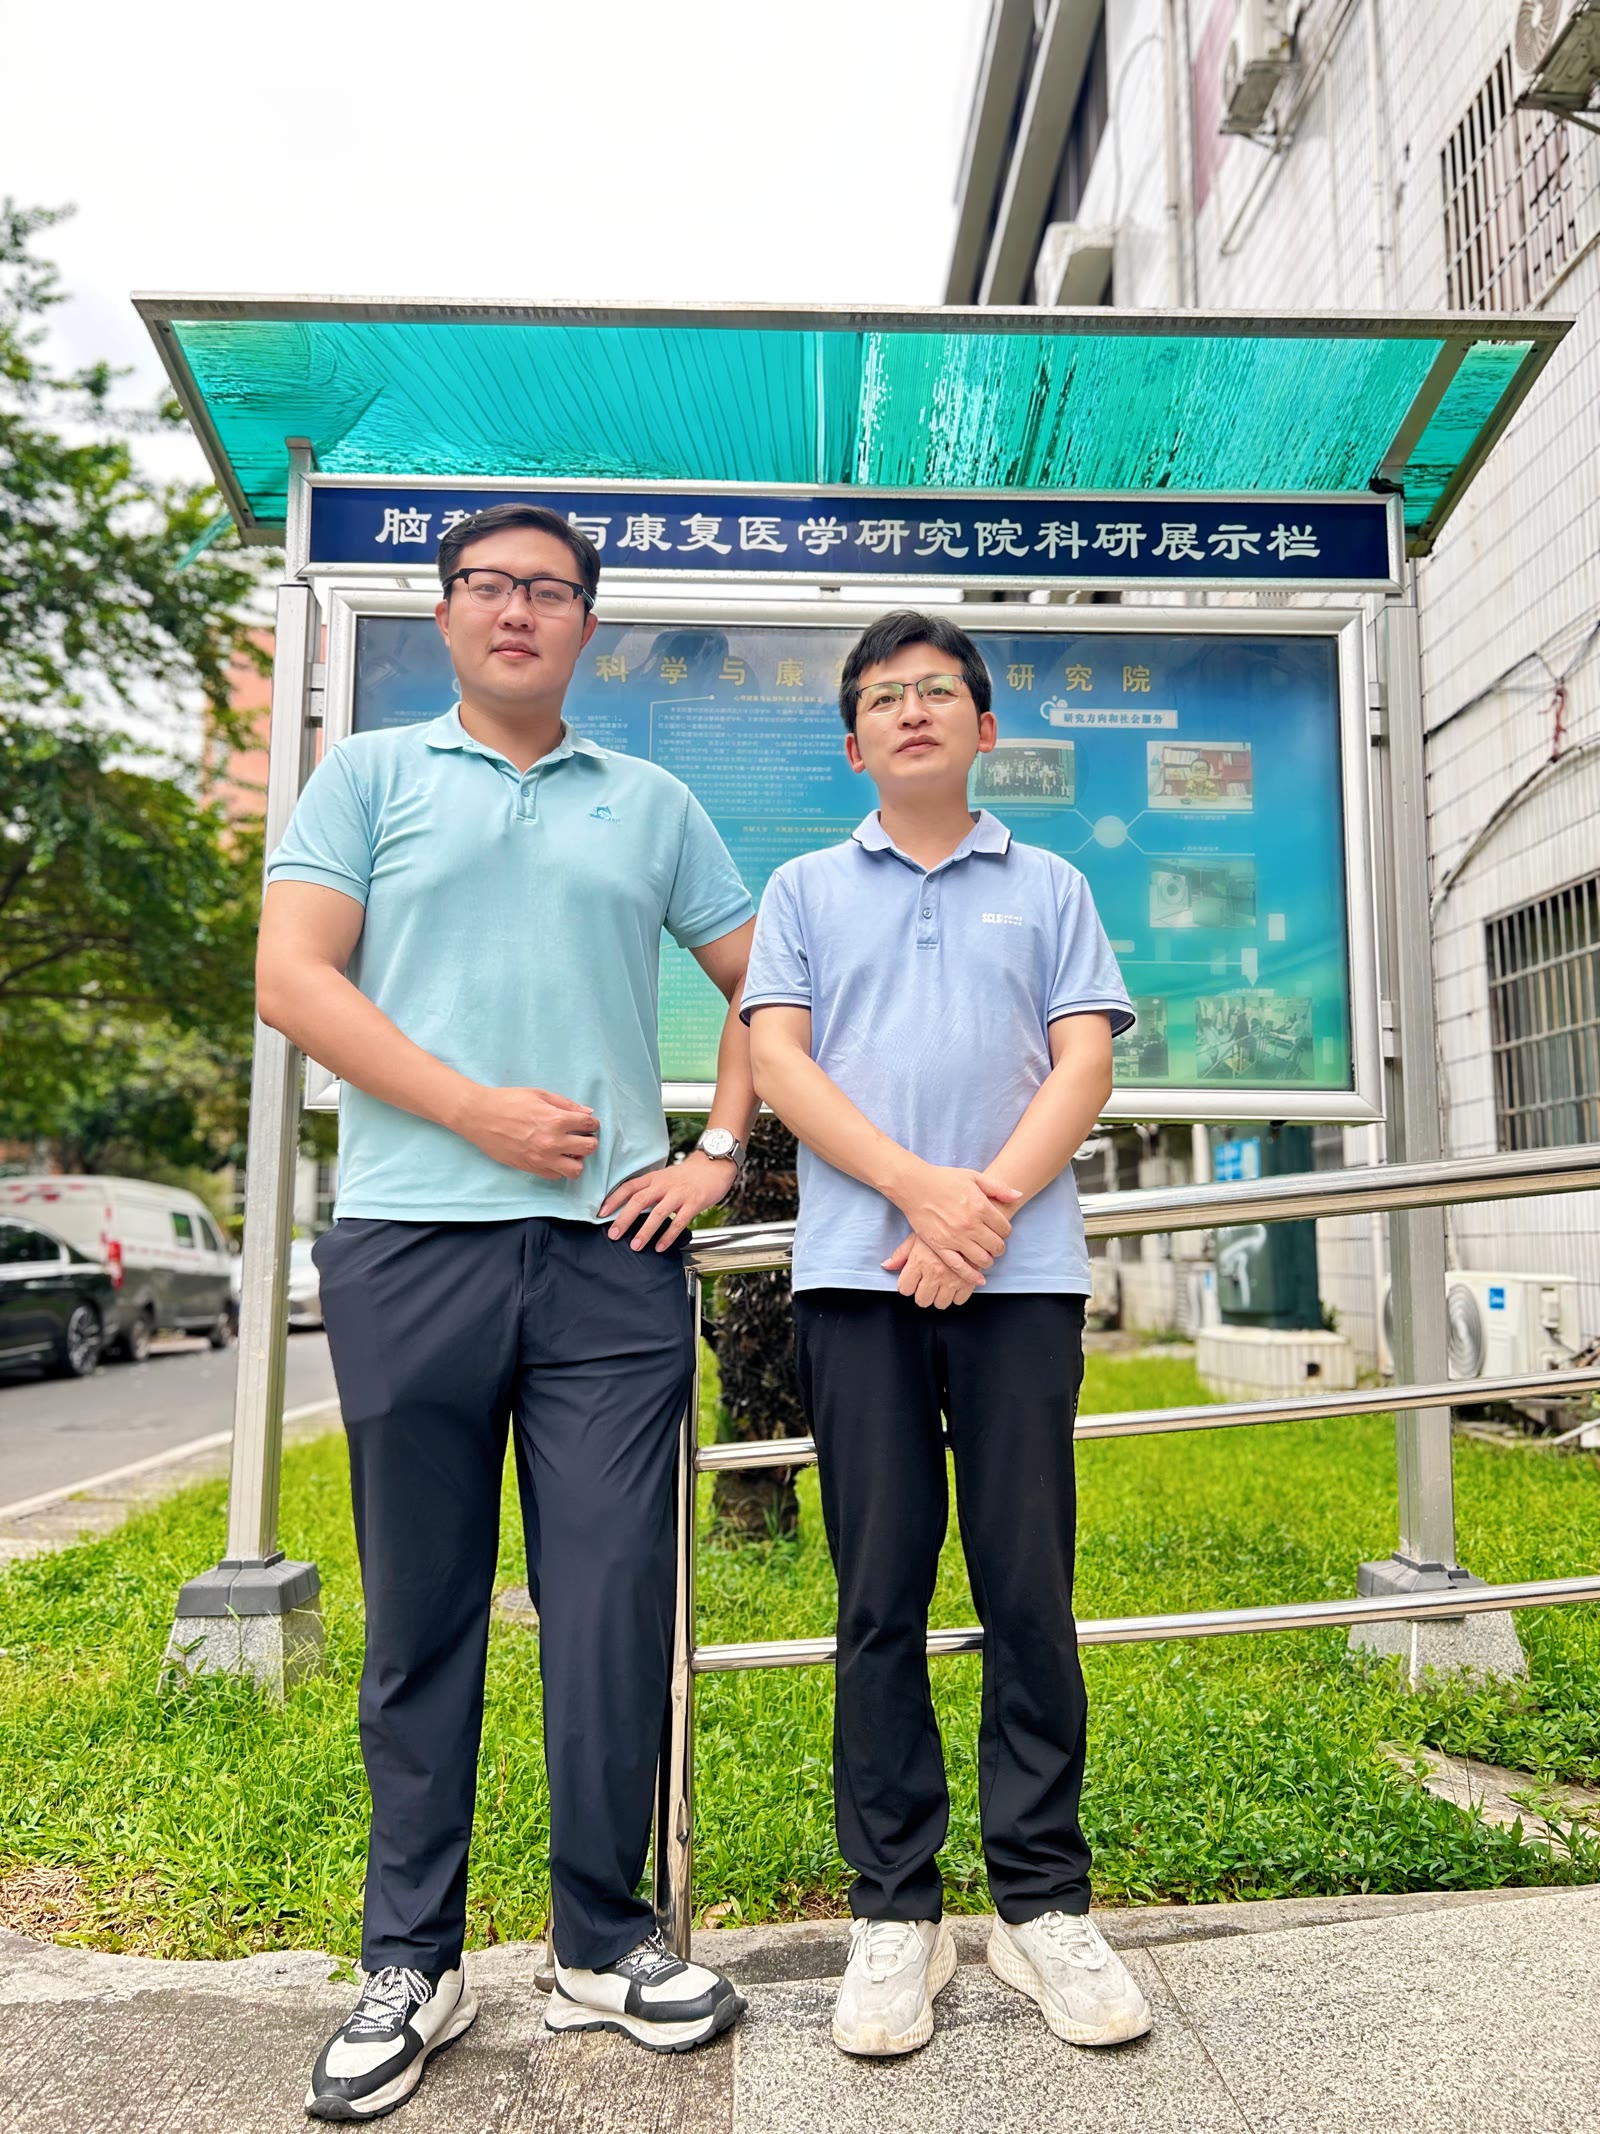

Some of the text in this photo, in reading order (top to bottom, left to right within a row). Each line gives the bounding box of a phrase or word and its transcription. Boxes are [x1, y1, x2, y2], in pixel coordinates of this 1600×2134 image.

[374, 506, 1322, 562] 脑与康复医学研究院科研展示栏
[1005, 663, 1152, 694] 研究院
[1063, 712, 1164, 726] 研究方向和社会服务
